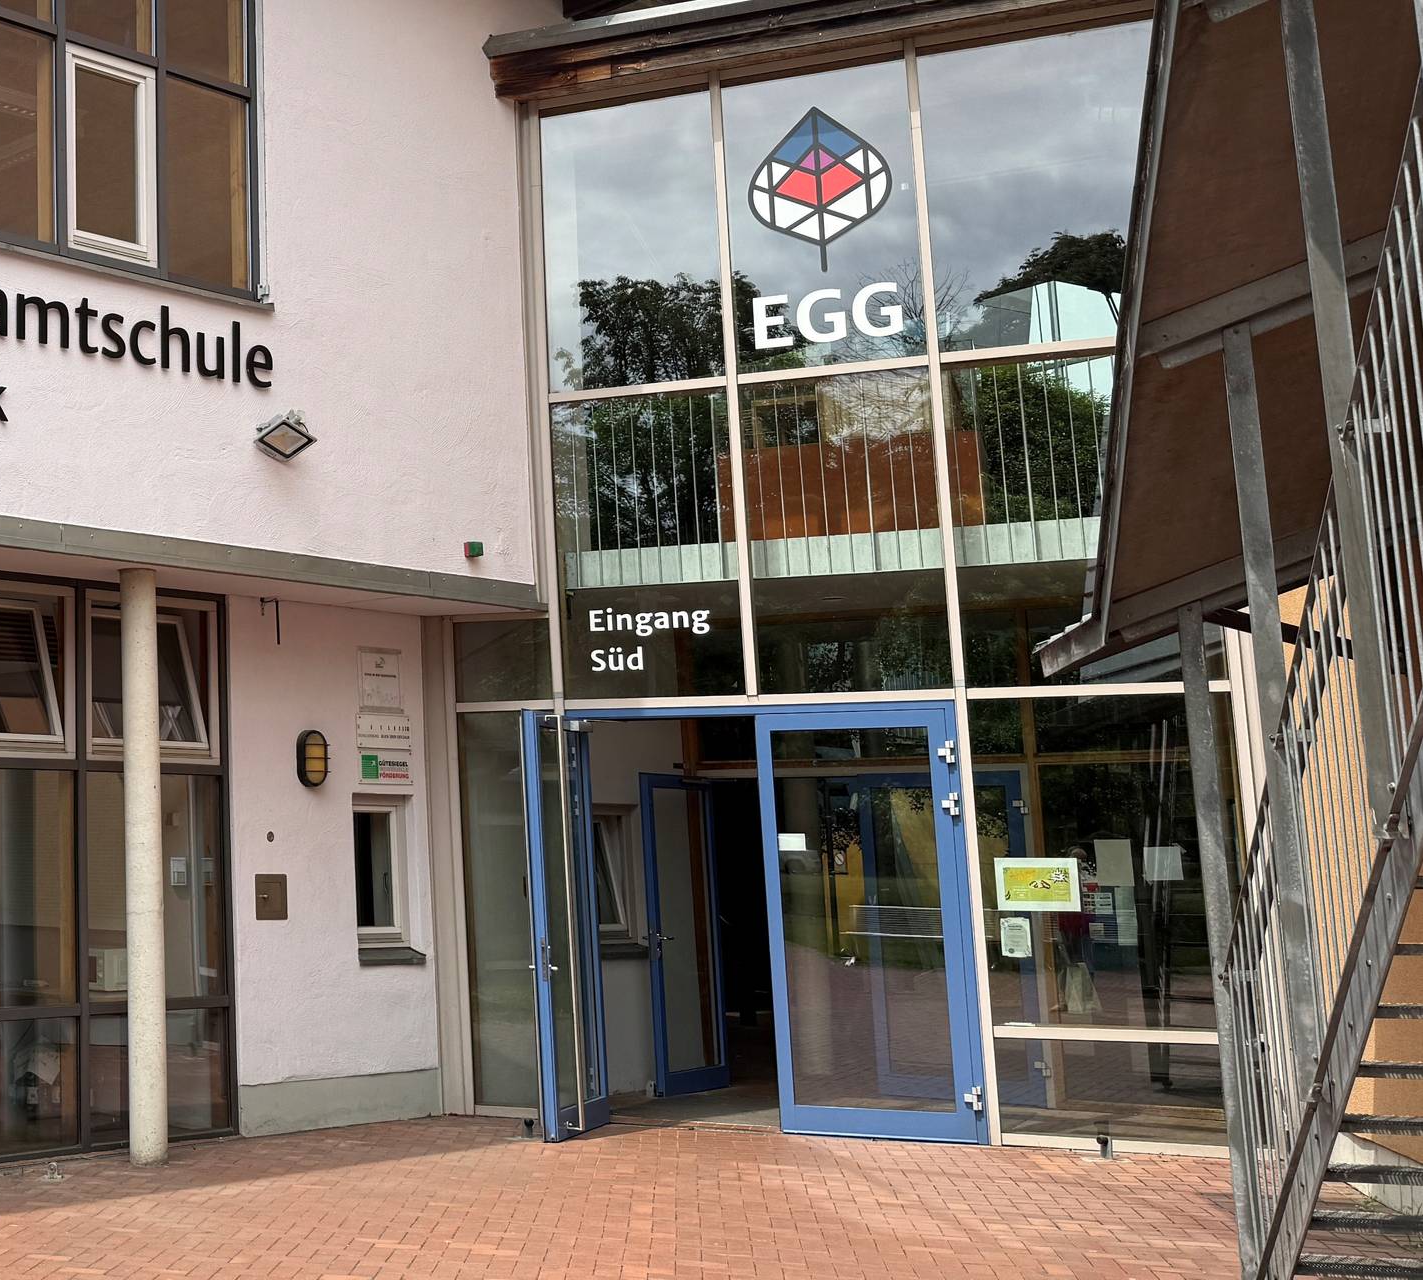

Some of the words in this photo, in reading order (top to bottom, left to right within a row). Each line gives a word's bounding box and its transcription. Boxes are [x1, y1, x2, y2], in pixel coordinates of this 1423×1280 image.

[752, 282, 904, 350] EGG
[588, 607, 711, 637] Eingang
[590, 645, 645, 672] Süd
